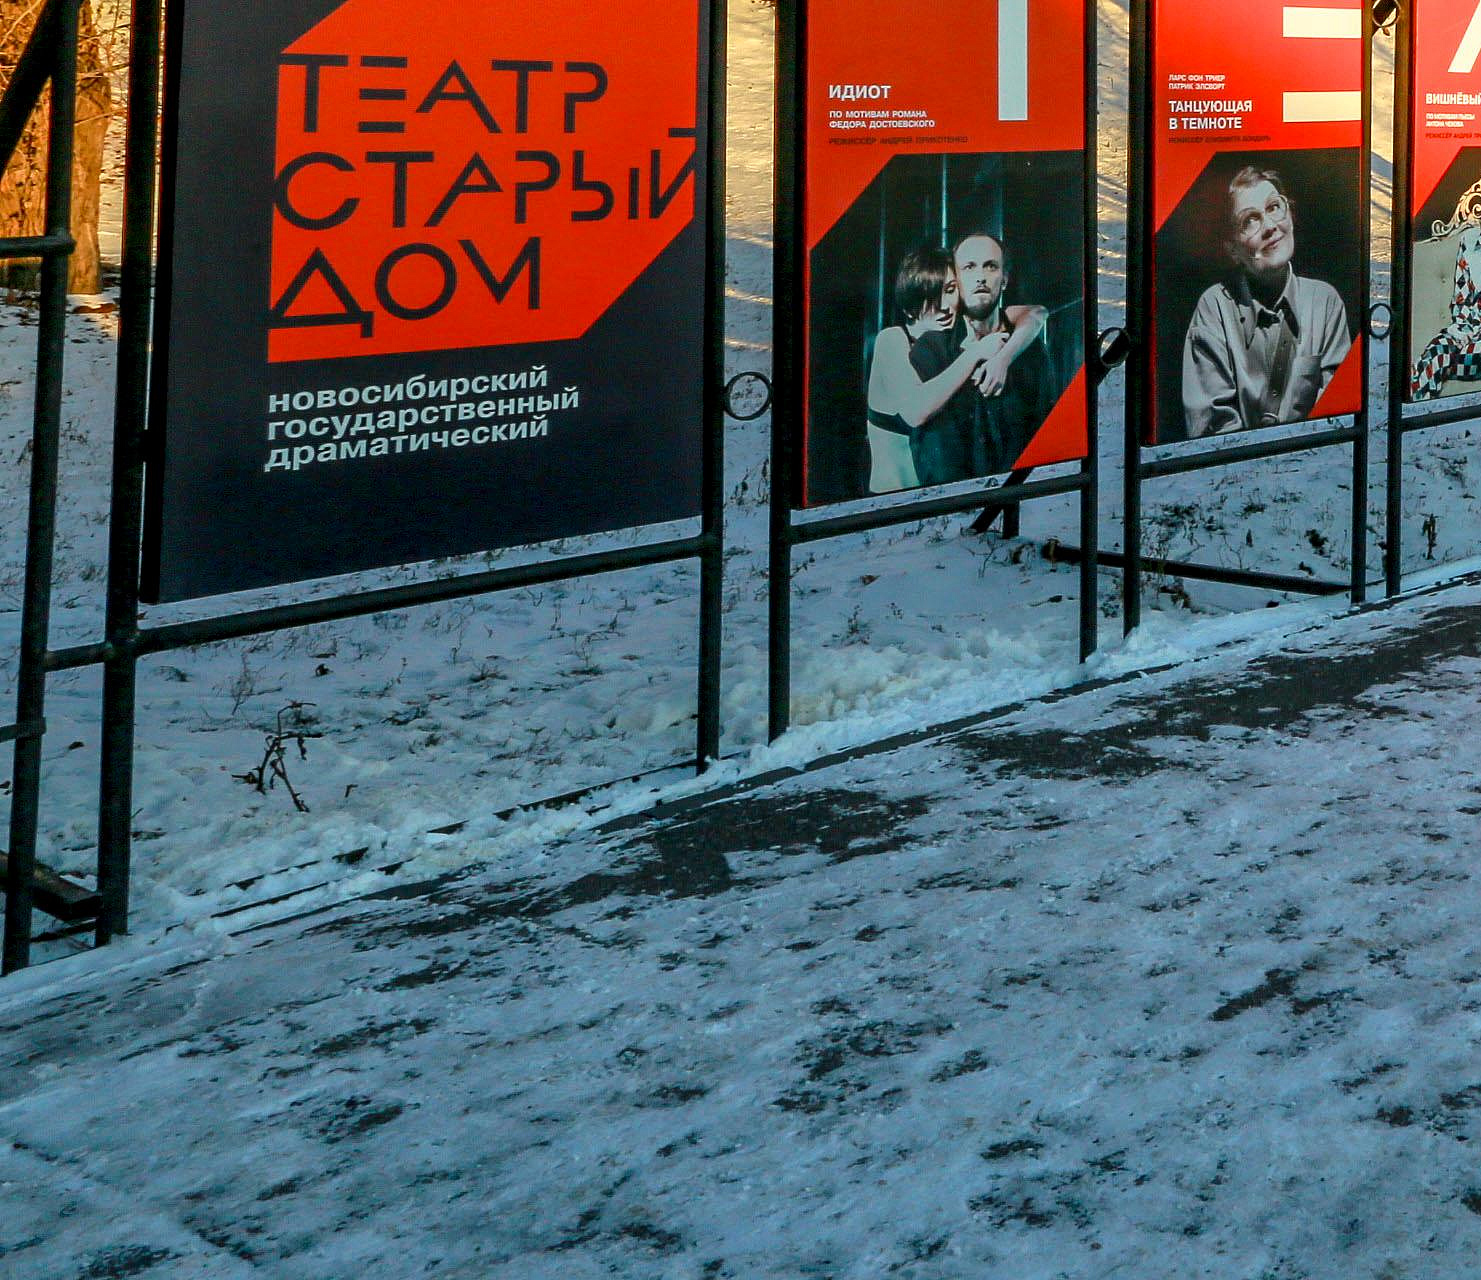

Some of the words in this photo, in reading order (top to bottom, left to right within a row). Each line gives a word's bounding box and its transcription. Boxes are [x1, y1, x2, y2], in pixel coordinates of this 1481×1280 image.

[280, 53, 608, 133] ТЕАТР
[828, 84, 892, 102] ИДИОТ
[829, 110, 843, 118] ПО
[845, 110, 889, 118] МОТИВАМ
[892, 110, 928, 118] РОМАНА
[1168, 100, 1253, 114] ТАНЦУЮЩАЯ
[869, 119, 936, 129] ДОСТОЕВСКОГО
[1169, 118, 1178, 130] В
[1181, 117, 1243, 129] ТЕМНОТЕ
[274, 127, 698, 230] СТАРЫЙ
[267, 236, 541, 338] ДОМ
[268, 365, 548, 413] новосибирский
[267, 386, 580, 441] государственный
[264, 414, 549, 472] драматический
